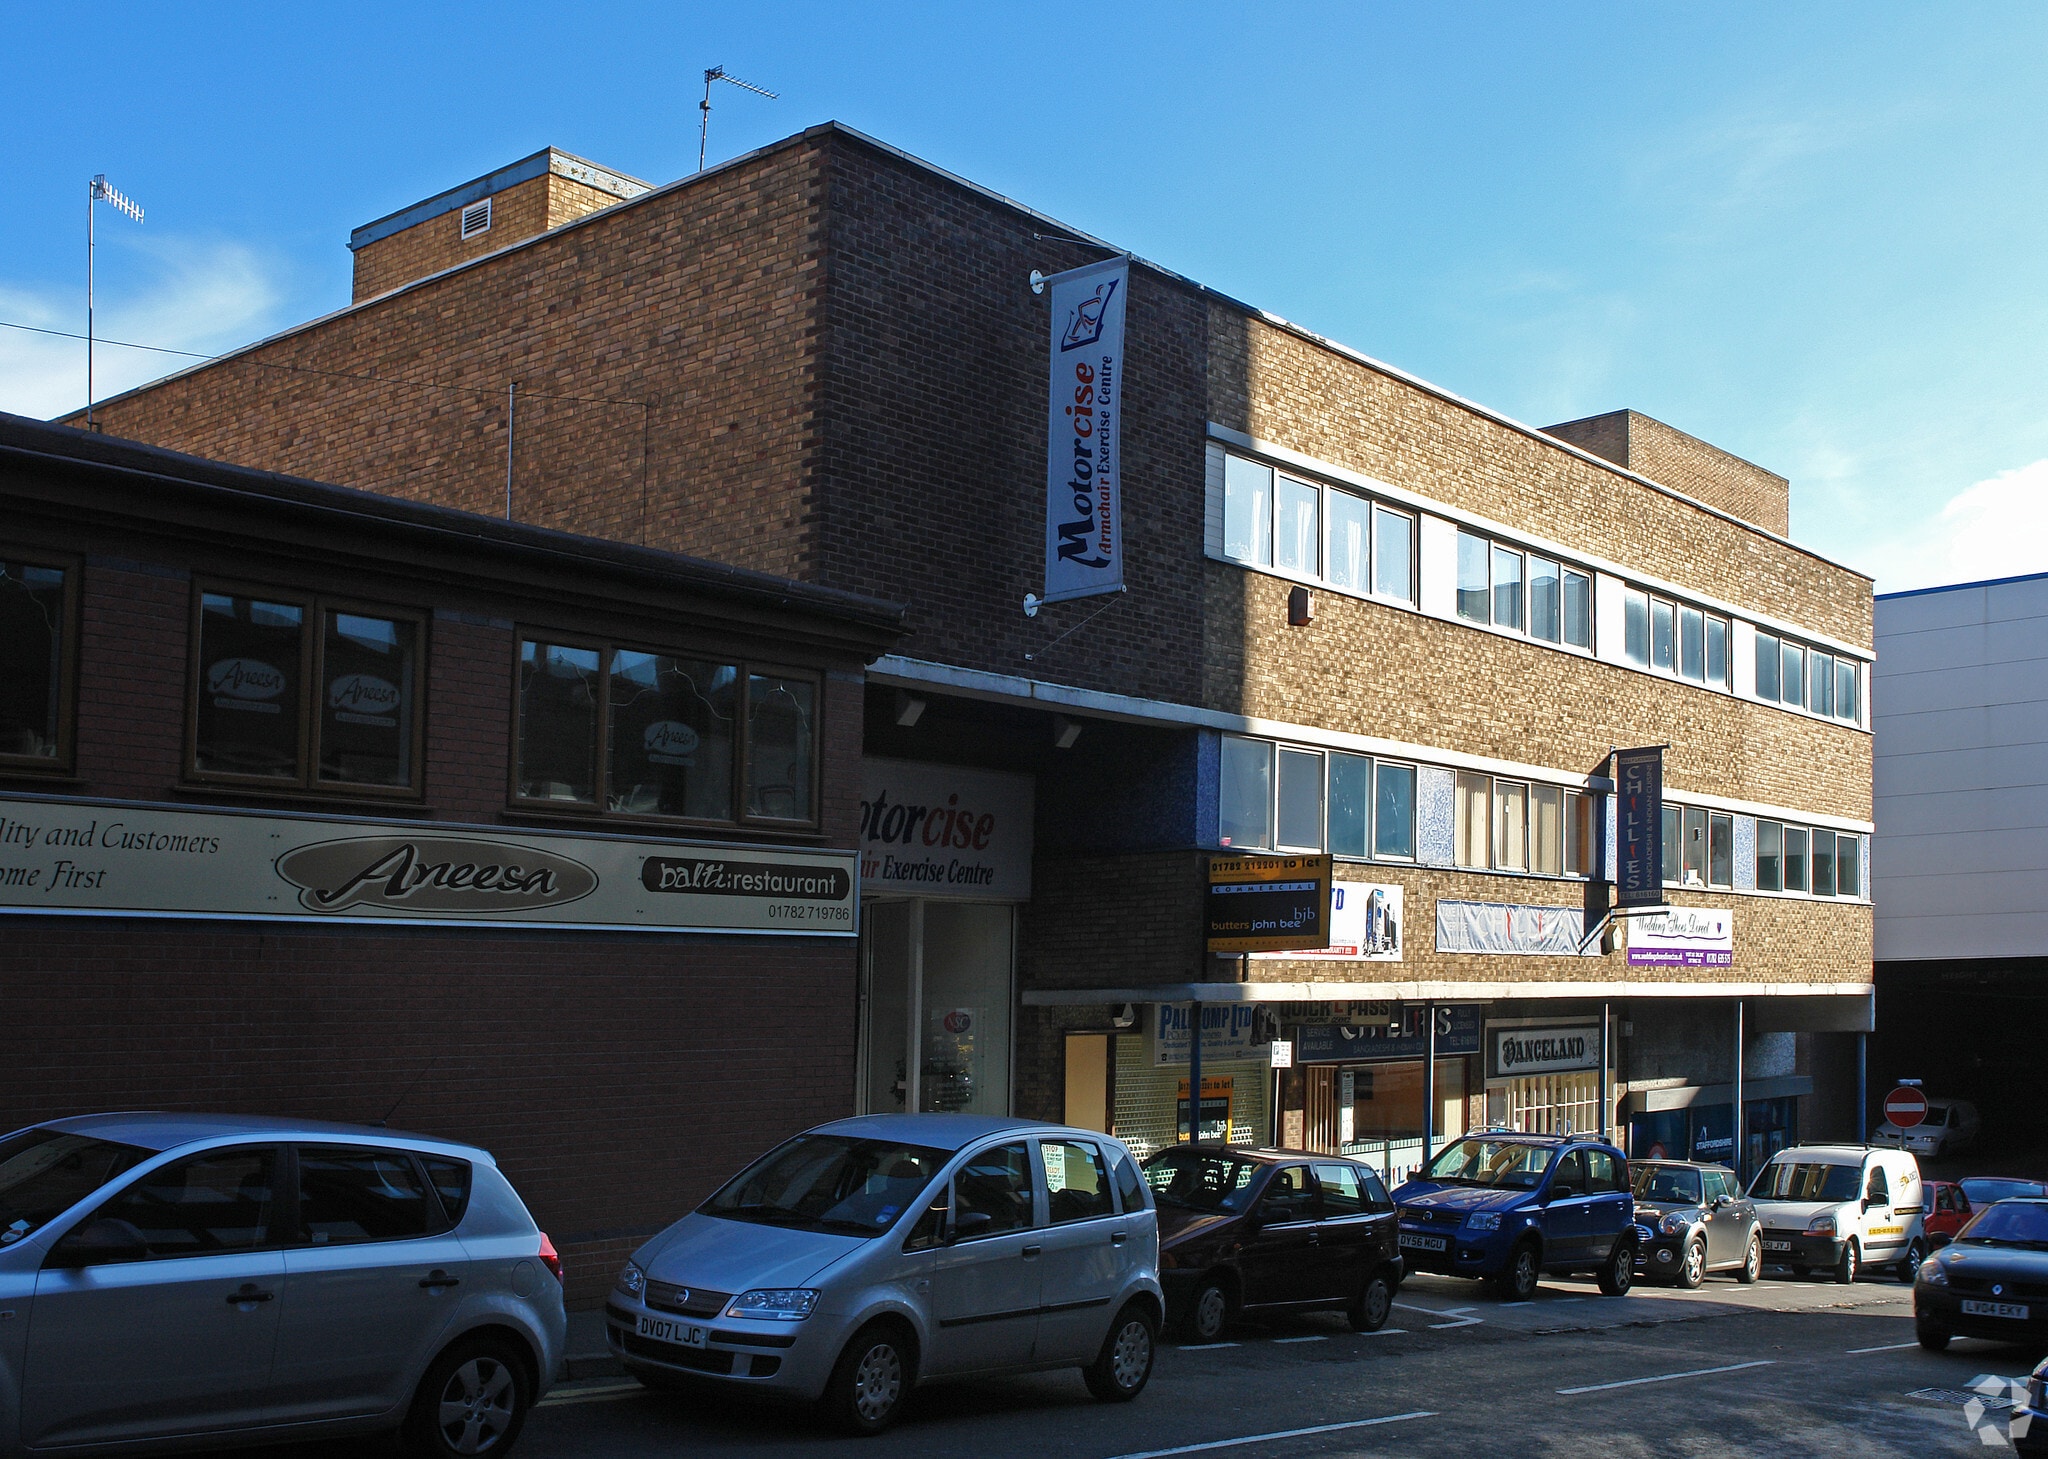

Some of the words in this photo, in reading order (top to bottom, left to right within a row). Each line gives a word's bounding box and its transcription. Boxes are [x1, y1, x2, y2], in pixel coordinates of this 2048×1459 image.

[1098, 355, 1113, 406] Centre
[1097, 418, 1111, 475] Exercise
[1057, 362, 1112, 570] Motorcise
[1097, 478, 1111, 555] Armchair
[45, 820, 97, 847] and
[101, 823, 220, 854] Customers
[1626, 765, 1643, 890] CHILLIES
[45, 859, 107, 892] First
[315, 843, 559, 905] Aneesa
[882, 854, 945, 883] Exercise
[947, 858, 994, 886] Centre
[1212, 862, 1241, 871] 01782
[1244, 861, 1280, 870] 212201
[1283, 859, 1297, 868] to
[1301, 857, 1320, 868] let
[1215, 883, 1313, 893] COMMERCIAL
[768, 904, 805, 919] 01782
[807, 905, 850, 921] 719786
[1211, 921, 1250, 931] butters
[1250, 919, 1277, 932] john
[1279, 918, 1301, 929] bee
[1293, 906, 1316, 923] bjb
[1688, 913, 1710, 934] Direct
[1302, 1040, 1334, 1051] AVAILABLE
[1502, 1036, 1585, 1068] DANCELAND
[1400, 1235, 1423, 1247] DY56
[641, 1317, 673, 1338] DV07
[674, 1324, 701, 1345] LJC
